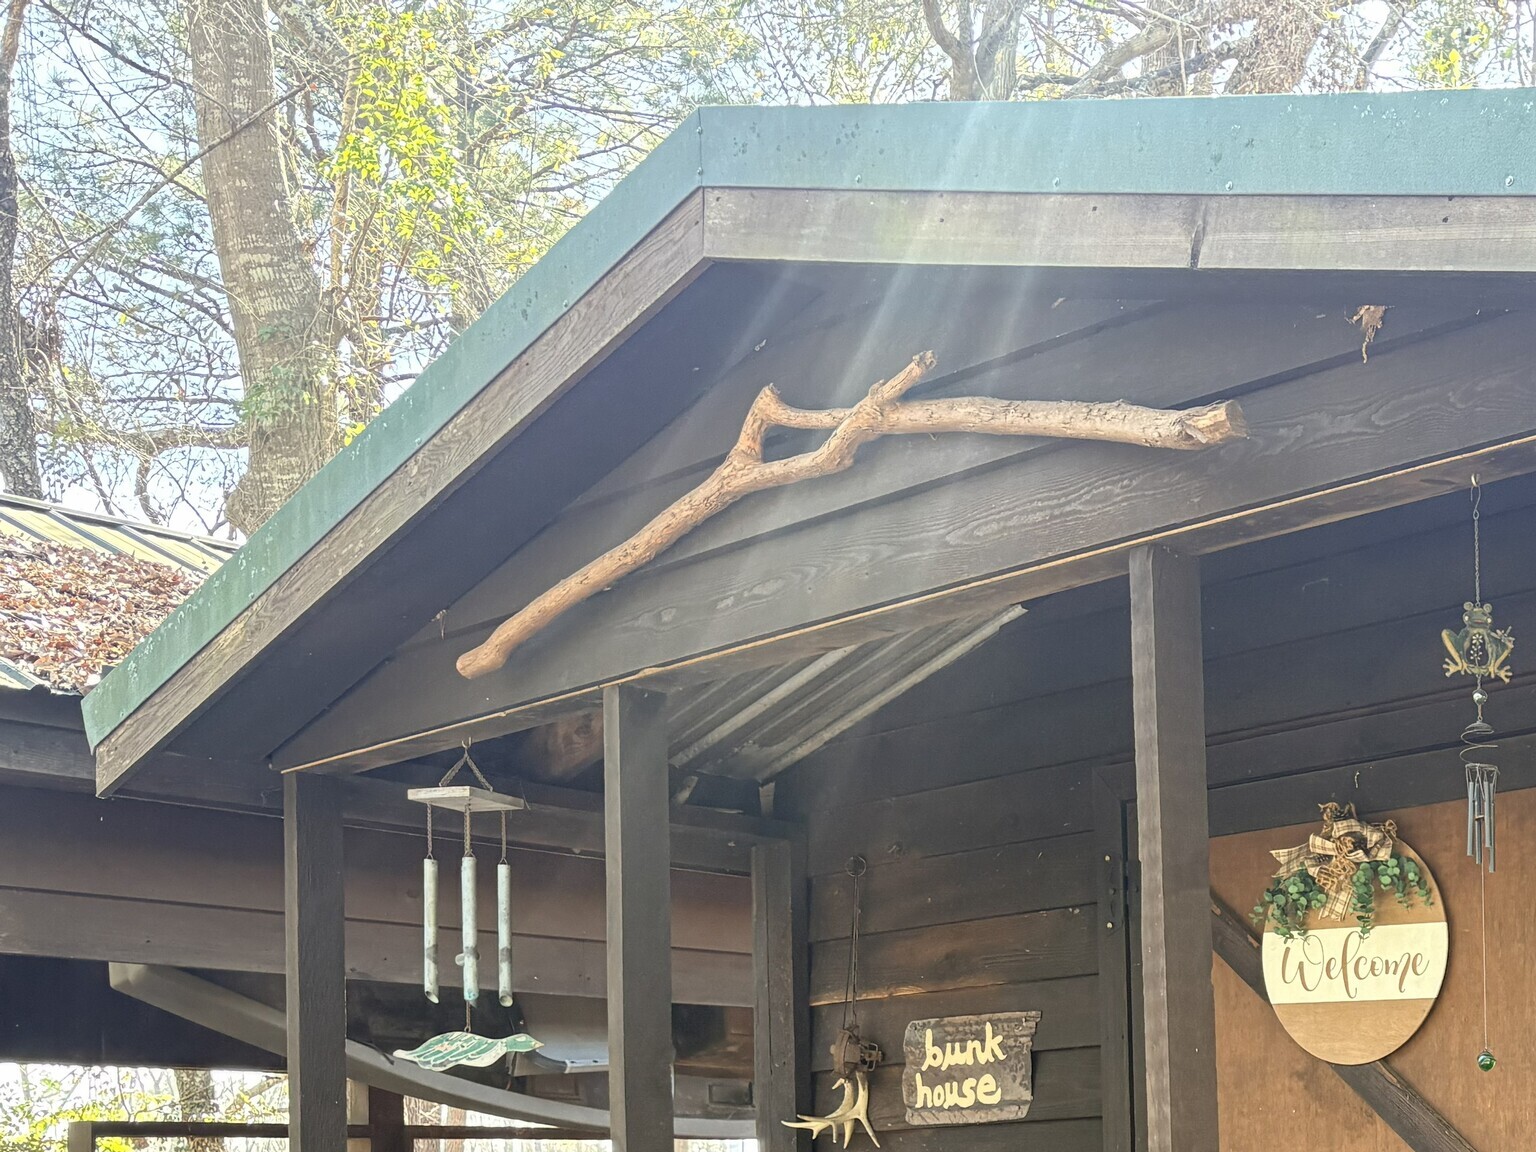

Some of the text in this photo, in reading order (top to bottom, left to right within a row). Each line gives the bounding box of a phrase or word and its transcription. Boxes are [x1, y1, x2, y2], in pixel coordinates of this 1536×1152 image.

[1281, 931, 1430, 999] Welcome
[922, 1021, 1007, 1071] bunk
[915, 1073, 1002, 1109] house
